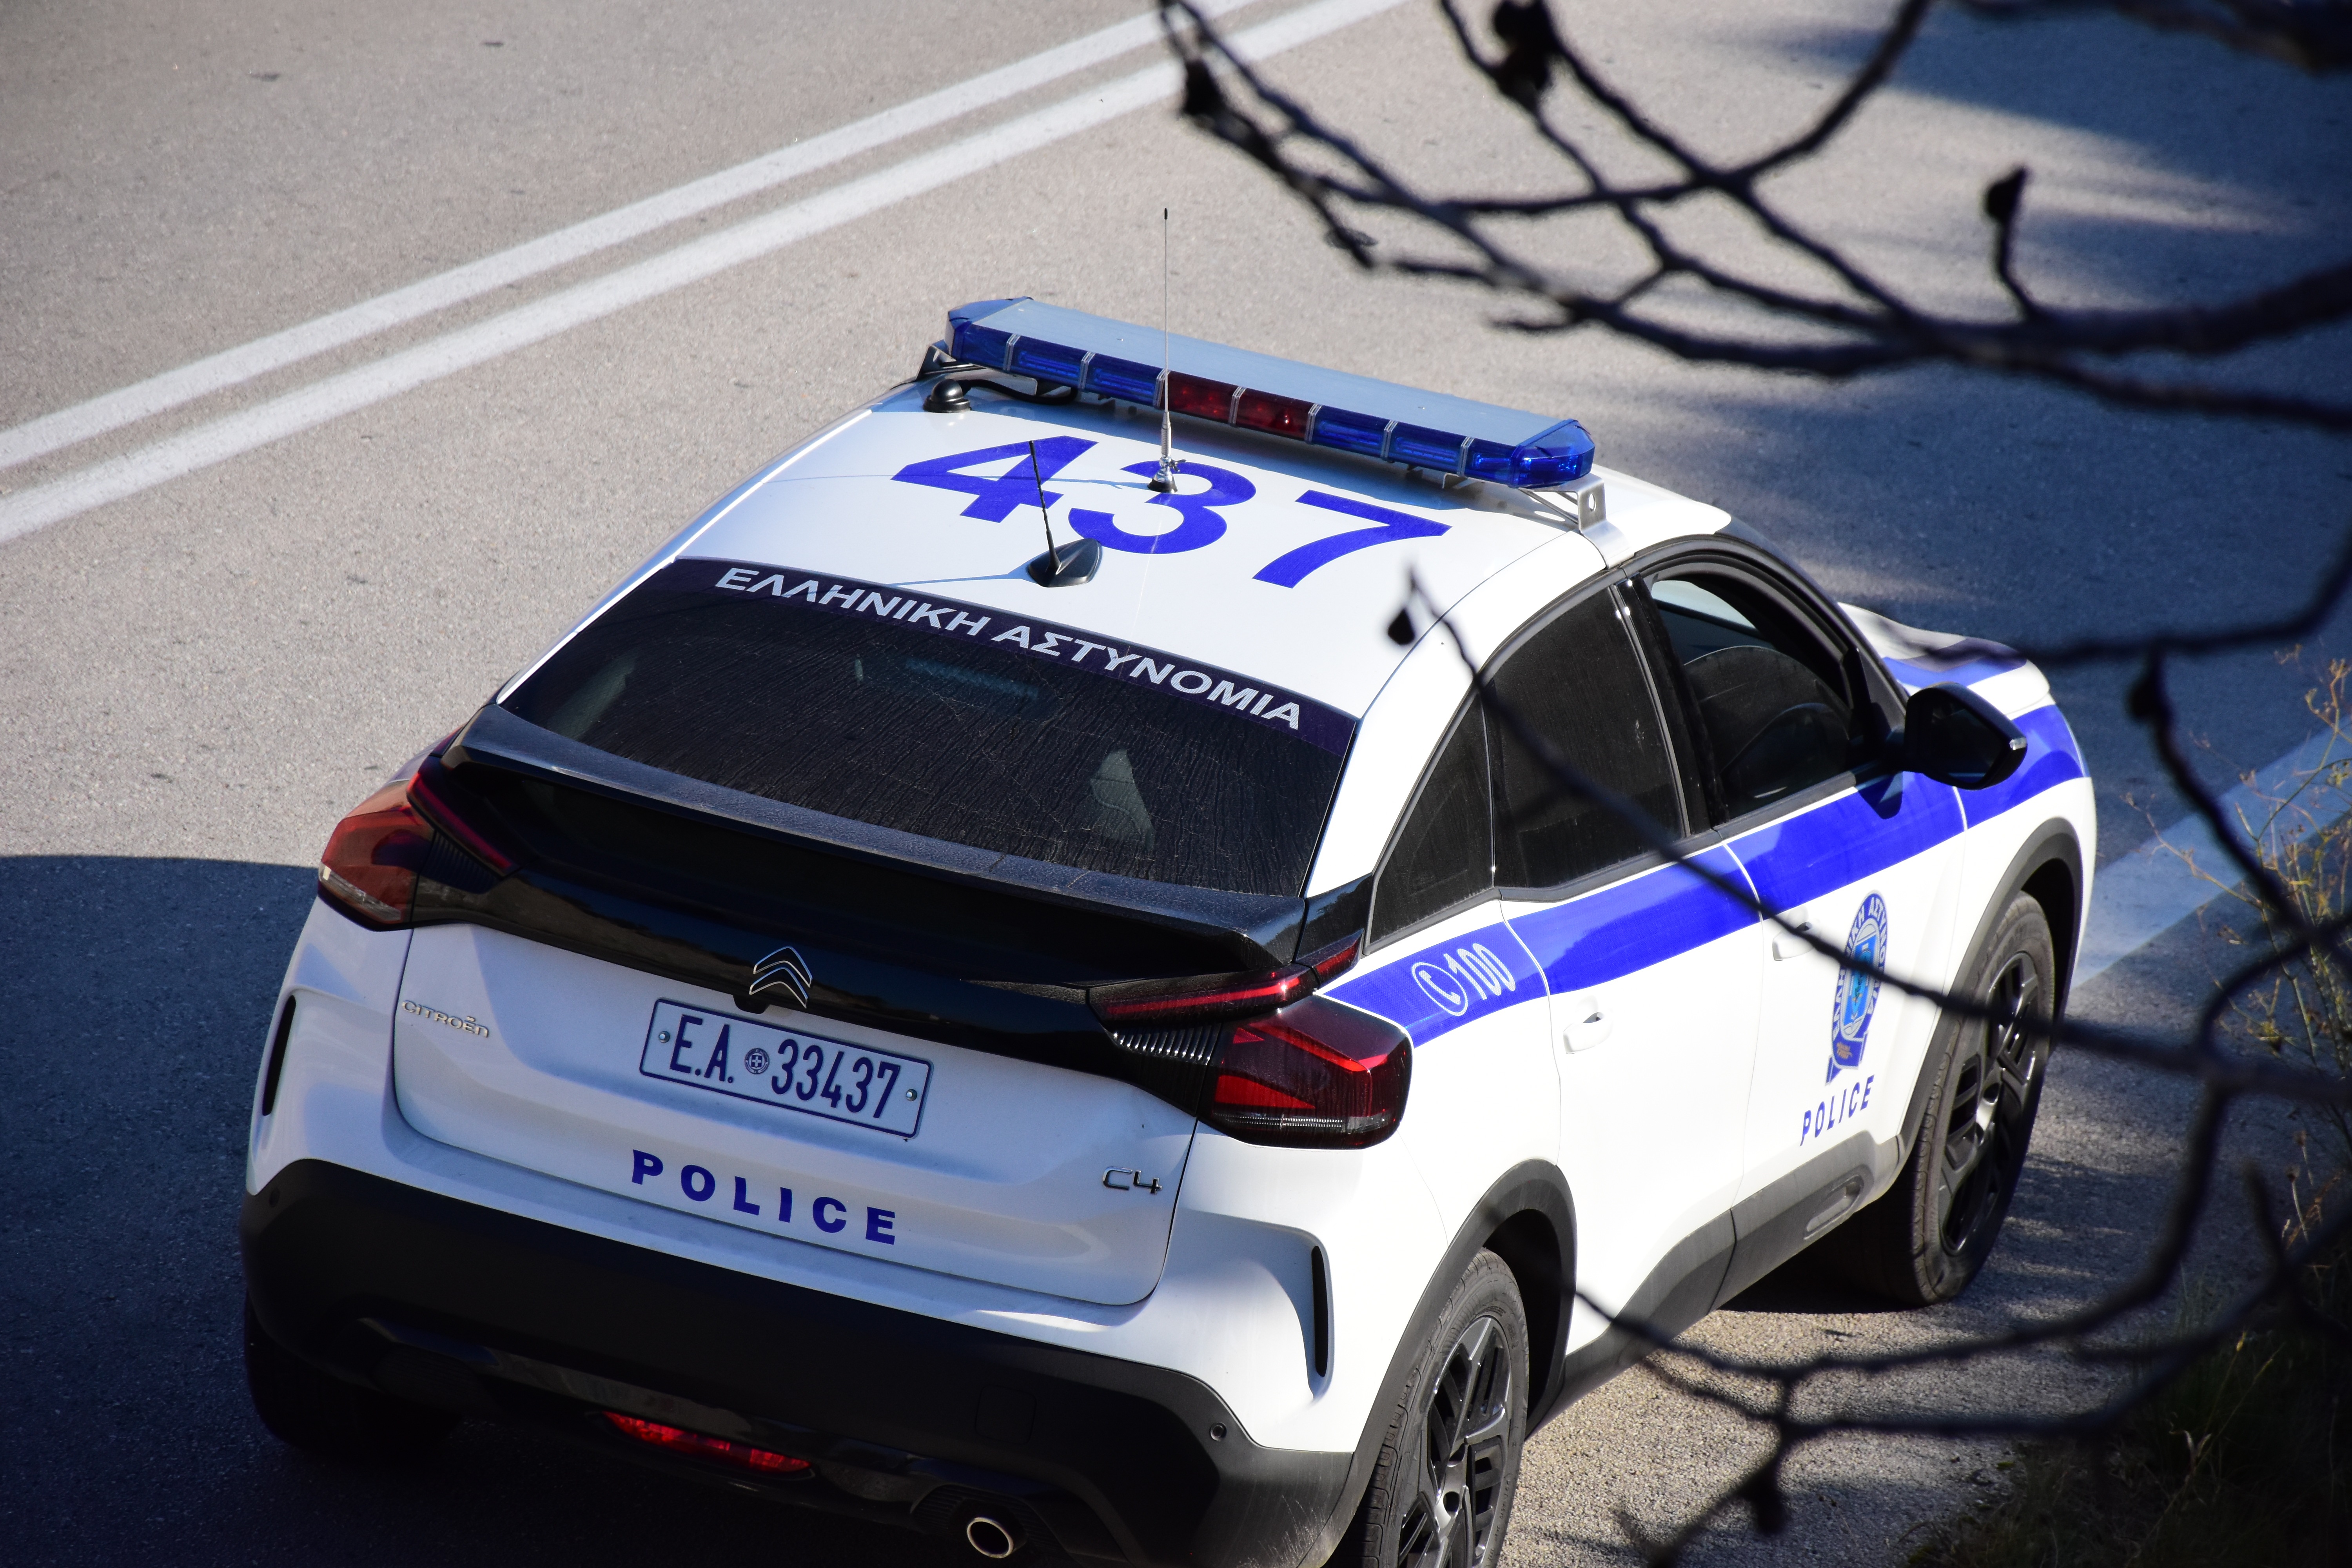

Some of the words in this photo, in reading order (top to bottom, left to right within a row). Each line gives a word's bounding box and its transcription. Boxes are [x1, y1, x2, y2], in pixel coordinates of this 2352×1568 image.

[892, 436, 1452, 588] 437
[715, 568, 991, 636] ΕΛΛΗΝΙΚΗ
[991, 625, 1299, 730] ΑΣΤΥΝΟΜΙΑ
[1443, 943, 1516, 1000] 100
[1832, 904, 1865, 1042] ΕΛΛΗΙΚΗ
[402, 1000, 490, 1038] CITROËN
[771, 1038, 901, 1118] 33437
[1800, 1074, 1875, 1147] POLICE
[632, 1149, 896, 1245] POLICE
[1102, 1166, 1163, 1195] C4
